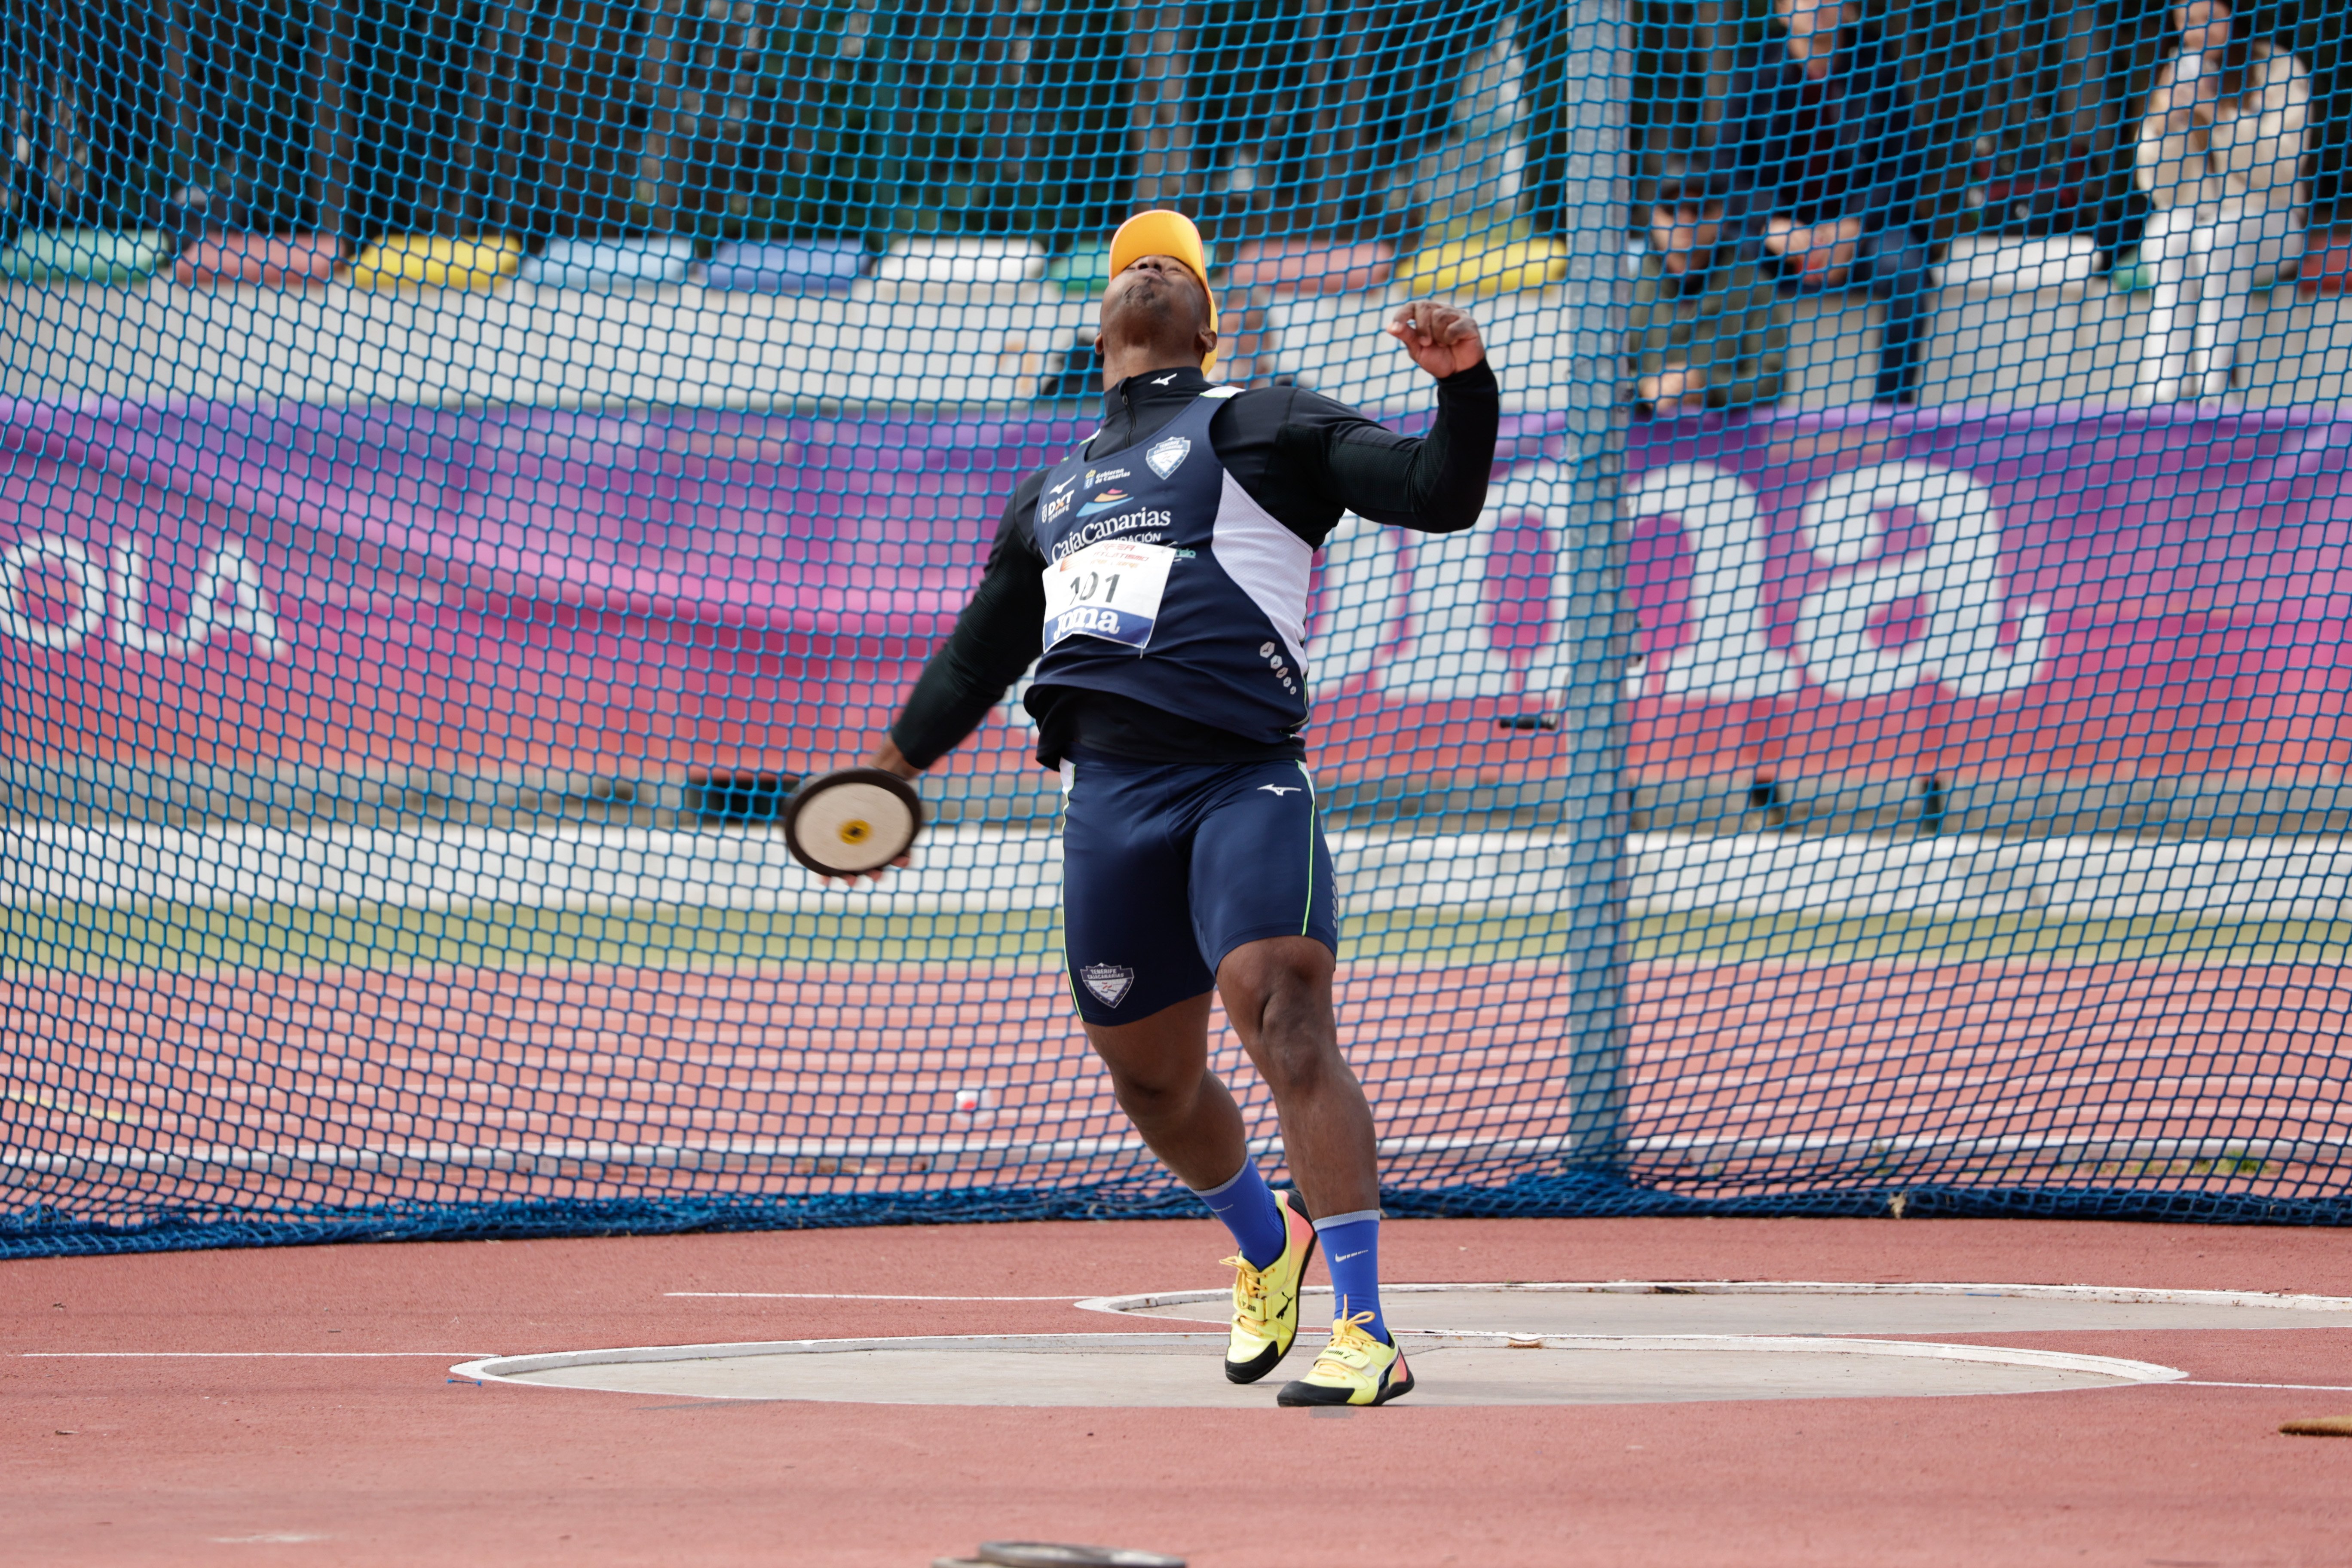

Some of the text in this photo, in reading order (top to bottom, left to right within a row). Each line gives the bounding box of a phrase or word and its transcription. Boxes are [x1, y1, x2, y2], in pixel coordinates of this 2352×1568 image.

[1096, 468, 1124, 479] Gobierno
[1103, 471, 1131, 481] Canarias
[1048, 489, 1075, 517] DXT
[1048, 503, 1070, 524] TENERIFE
[1051, 506, 1171, 564] CajaCanarias
[1111, 531, 1161, 543] DACIÓN
[1069, 571, 1121, 606] 101
